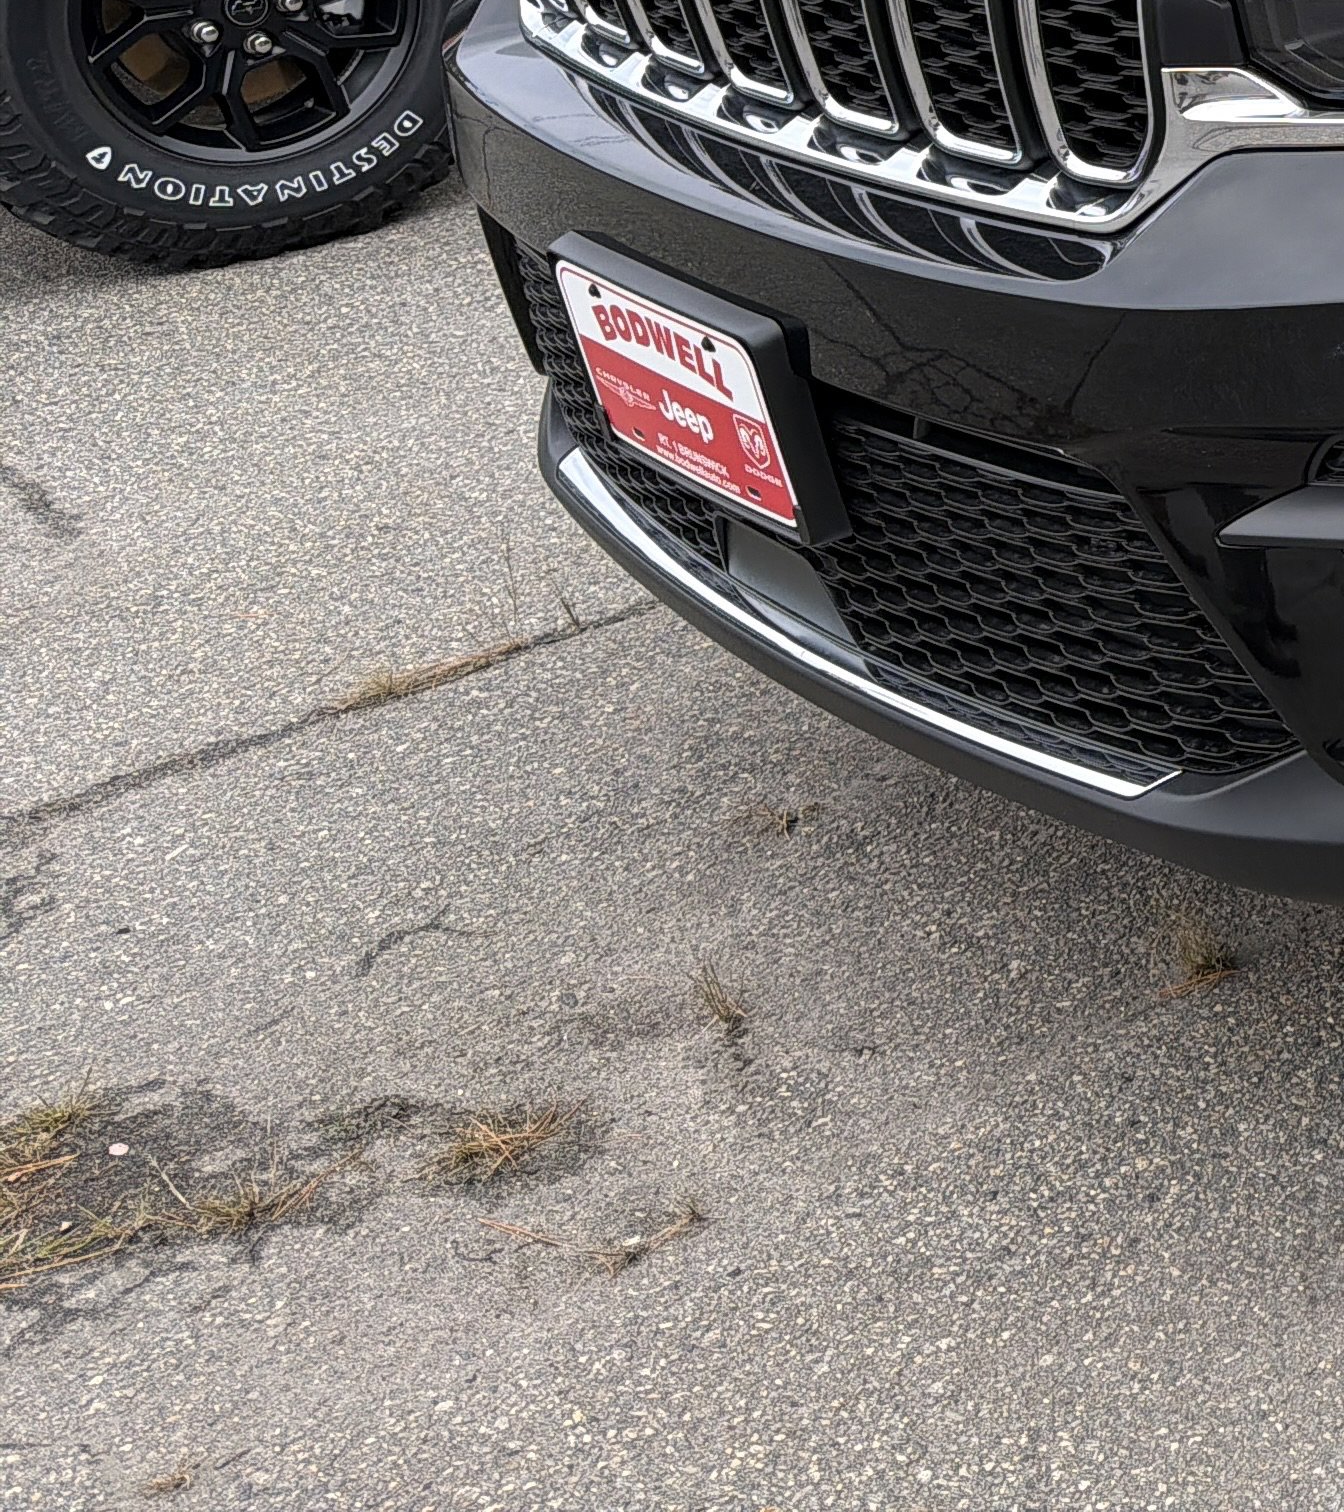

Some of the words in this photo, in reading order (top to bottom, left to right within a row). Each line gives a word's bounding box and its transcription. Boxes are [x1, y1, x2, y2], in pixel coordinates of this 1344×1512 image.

[118, 110, 423, 207] DESTINATION
[591, 304, 734, 402] BODWELL
[658, 389, 714, 444] Jeep
